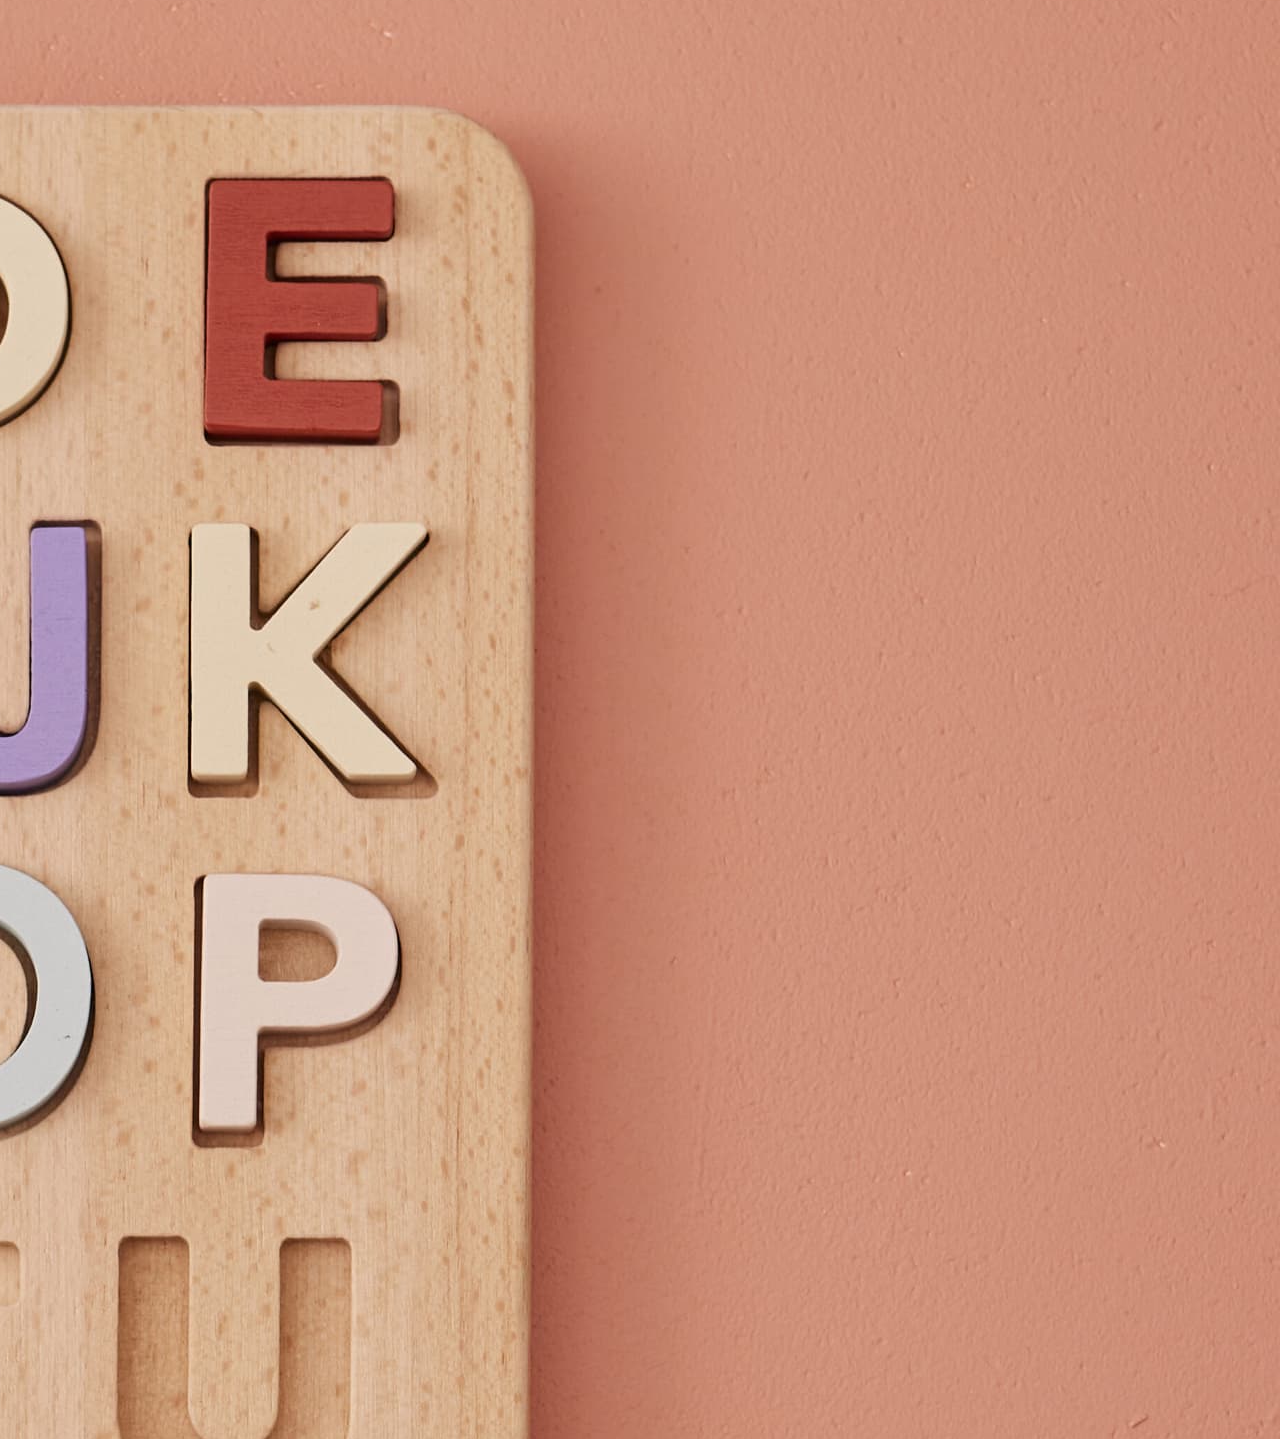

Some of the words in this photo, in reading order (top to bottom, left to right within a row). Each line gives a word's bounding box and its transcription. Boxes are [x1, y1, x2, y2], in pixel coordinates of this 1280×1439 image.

[203, 177, 397, 444] E
[186, 521, 437, 794] K
[194, 872, 400, 1146] P
